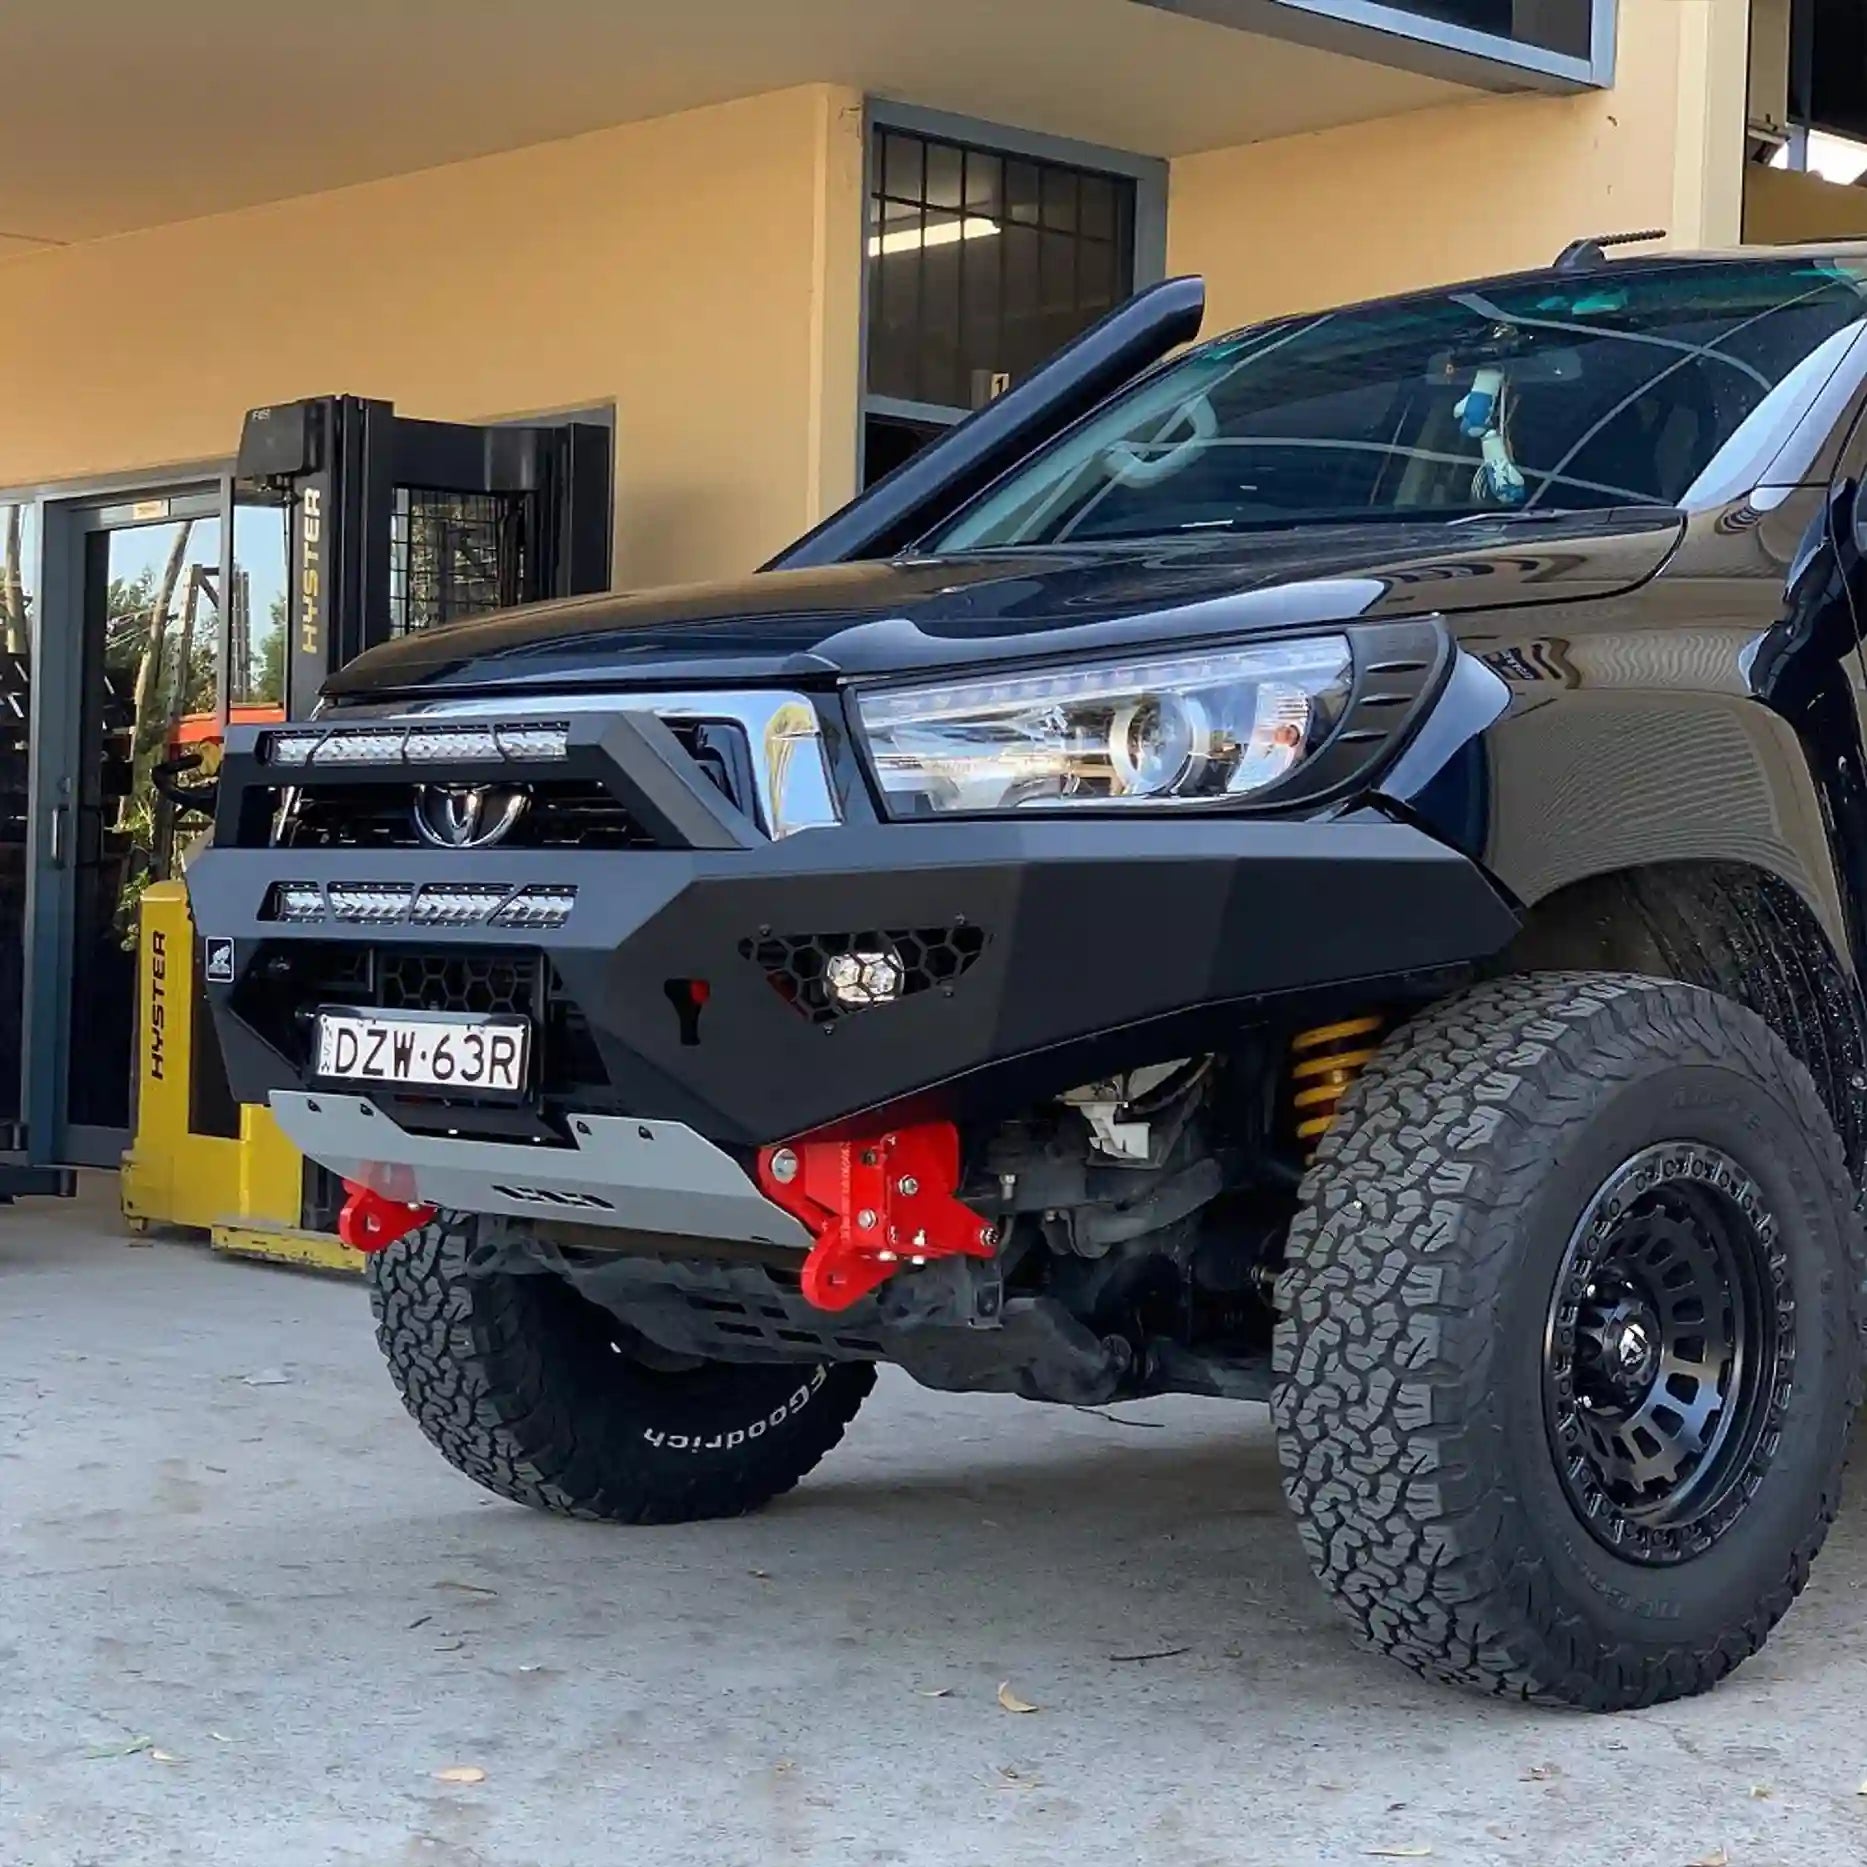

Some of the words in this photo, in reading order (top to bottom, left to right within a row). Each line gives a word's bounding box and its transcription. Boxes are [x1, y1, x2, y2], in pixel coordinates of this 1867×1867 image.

[302, 487, 321, 654] HYSTER
[151, 930, 166, 1080] HYSTER
[643, 1362, 835, 1453] FGoodrich
